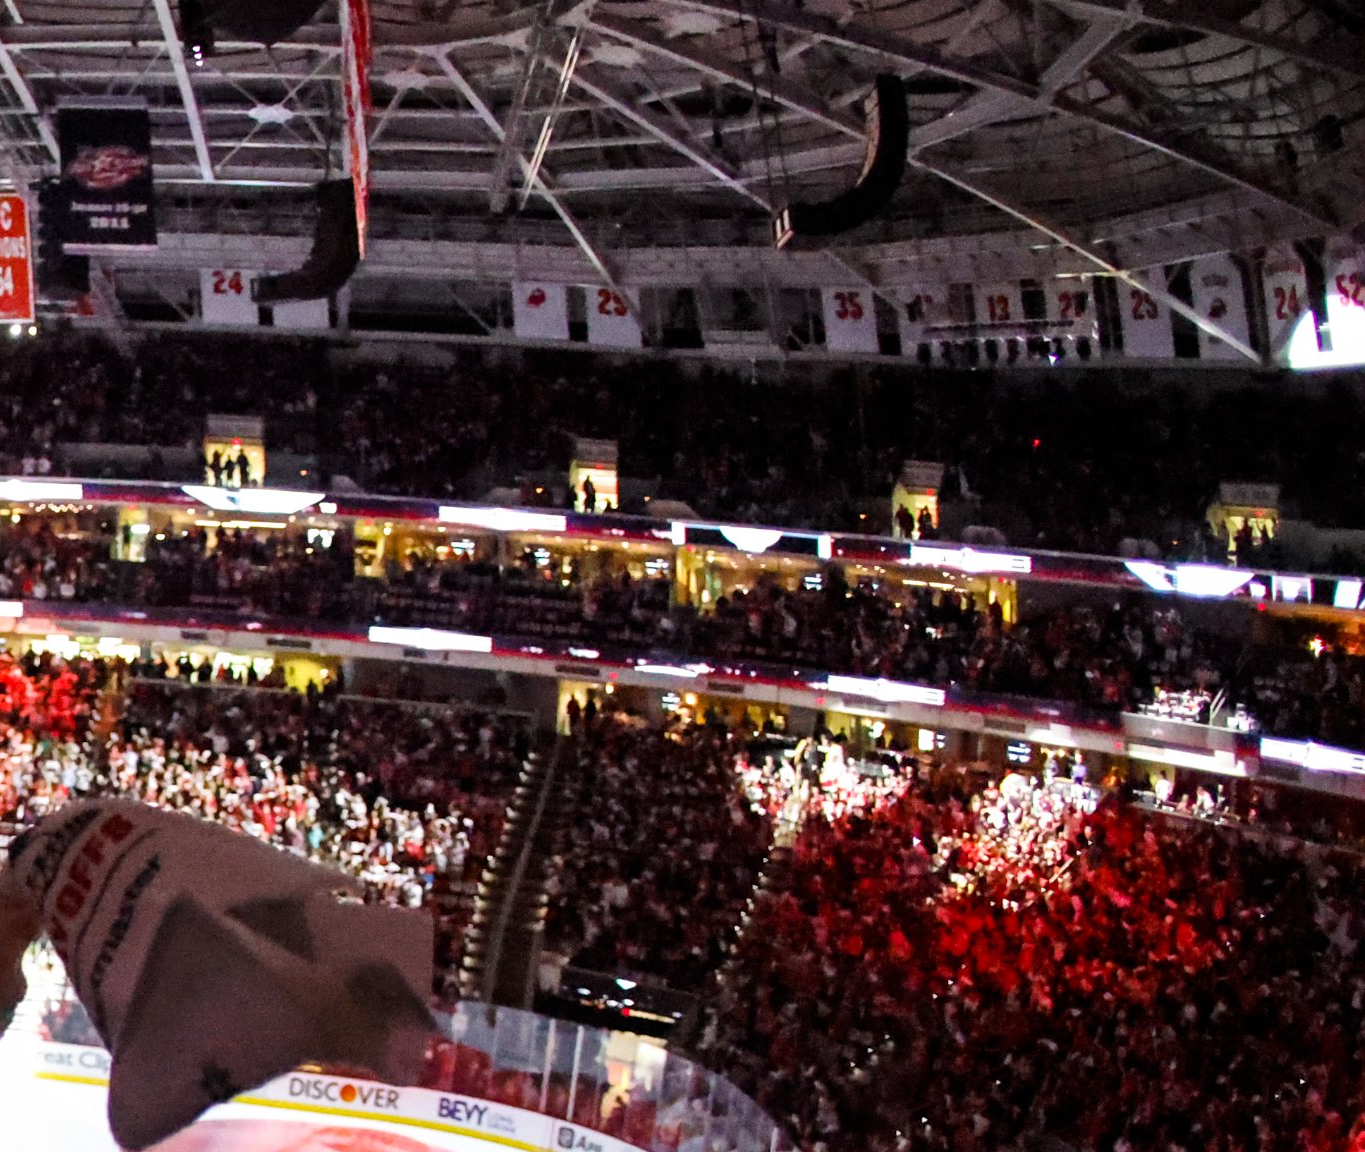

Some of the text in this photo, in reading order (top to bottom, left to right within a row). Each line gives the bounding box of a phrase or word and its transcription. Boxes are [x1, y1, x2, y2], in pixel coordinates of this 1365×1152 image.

[212, 270, 244, 295] 24
[834, 291, 863, 320] 35
[1274, 285, 1300, 320] 24
[289, 1077, 400, 1110] DISCOVER
[438, 1097, 488, 1126] BEVY
